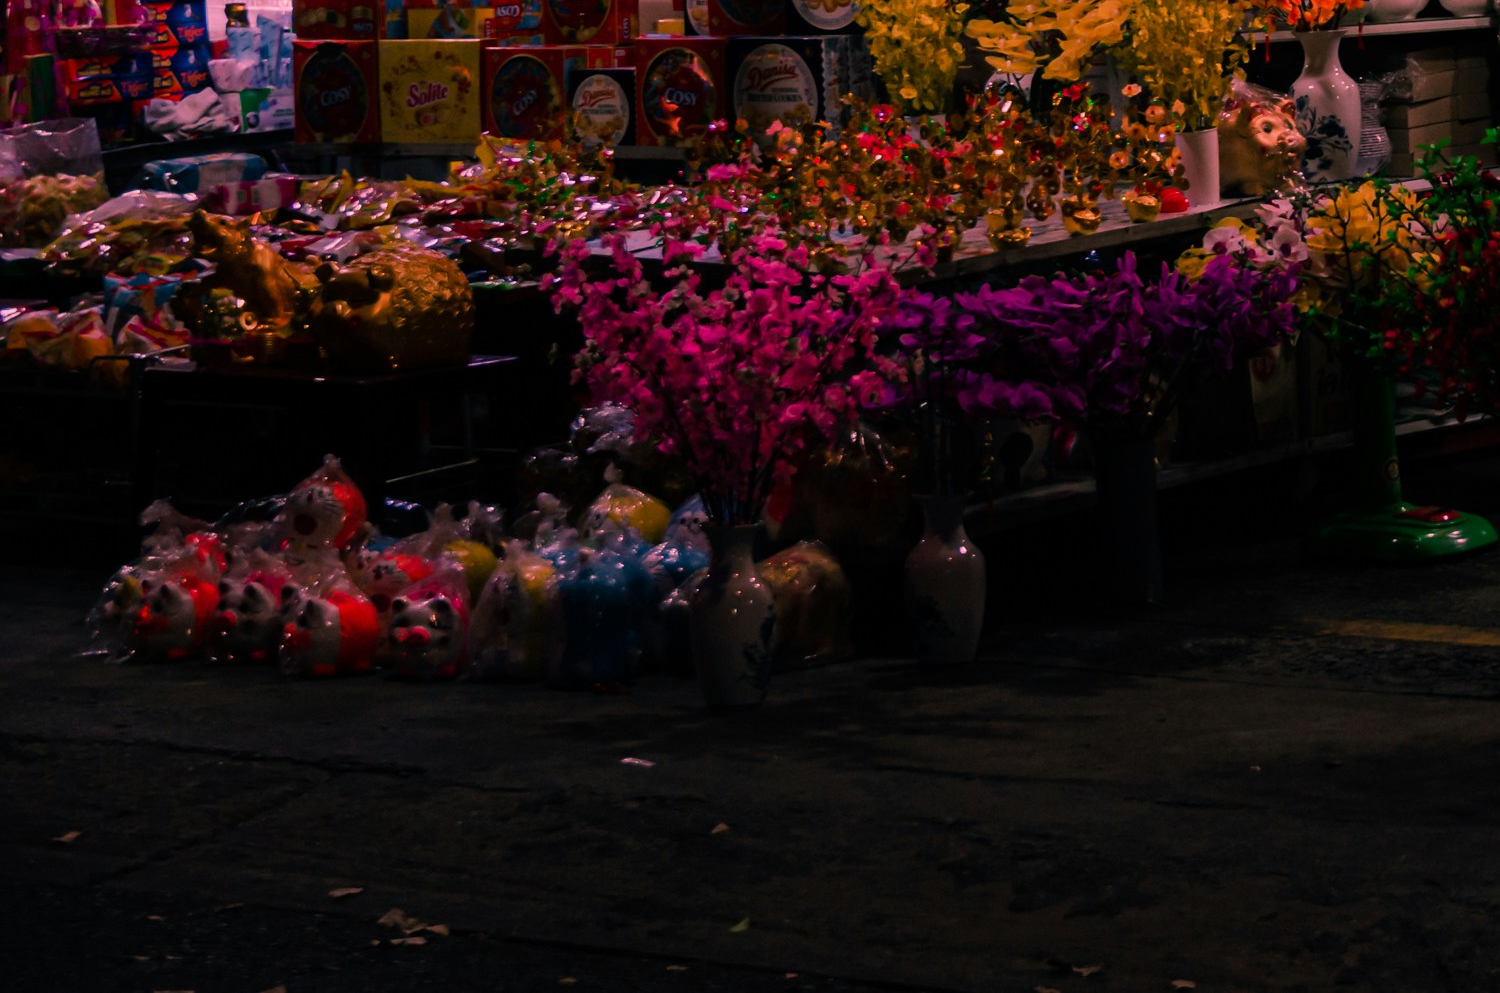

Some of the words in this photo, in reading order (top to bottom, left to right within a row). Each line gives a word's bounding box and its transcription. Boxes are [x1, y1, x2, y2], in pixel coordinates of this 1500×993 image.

[495, 5, 521, 18] COSY
[176, 25, 205, 43] Tiger
[179, 71, 208, 89] Tiger
[744, 61, 800, 92] Danisa
[320, 86, 354, 108] COSY
[407, 80, 449, 108] Solite
[512, 89, 539, 117] COSY
[663, 86, 699, 107] COSY
